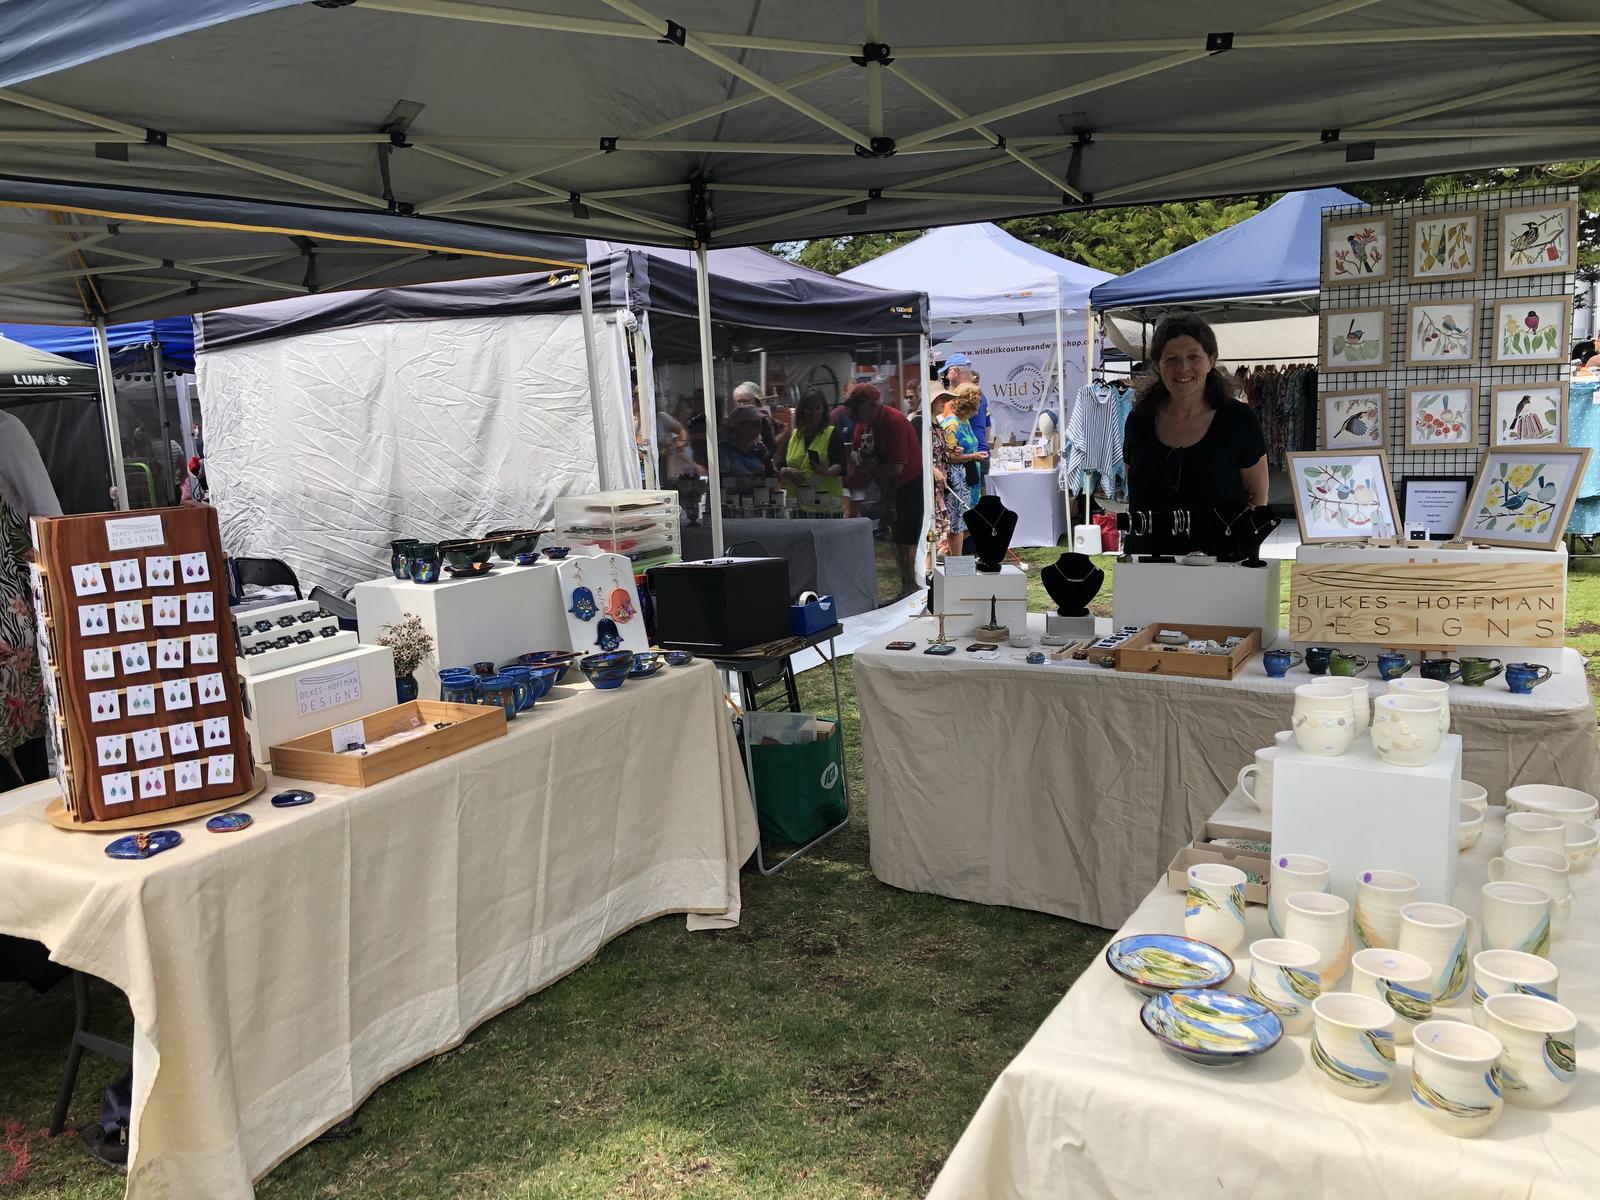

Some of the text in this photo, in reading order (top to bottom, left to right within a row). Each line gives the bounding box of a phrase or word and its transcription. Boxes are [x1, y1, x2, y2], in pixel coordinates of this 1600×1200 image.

[993, 380, 1060, 397] Wild Sik
[1297, 616, 1555, 639] DESIGNS
[300, 686, 360, 714] DESIGNS
